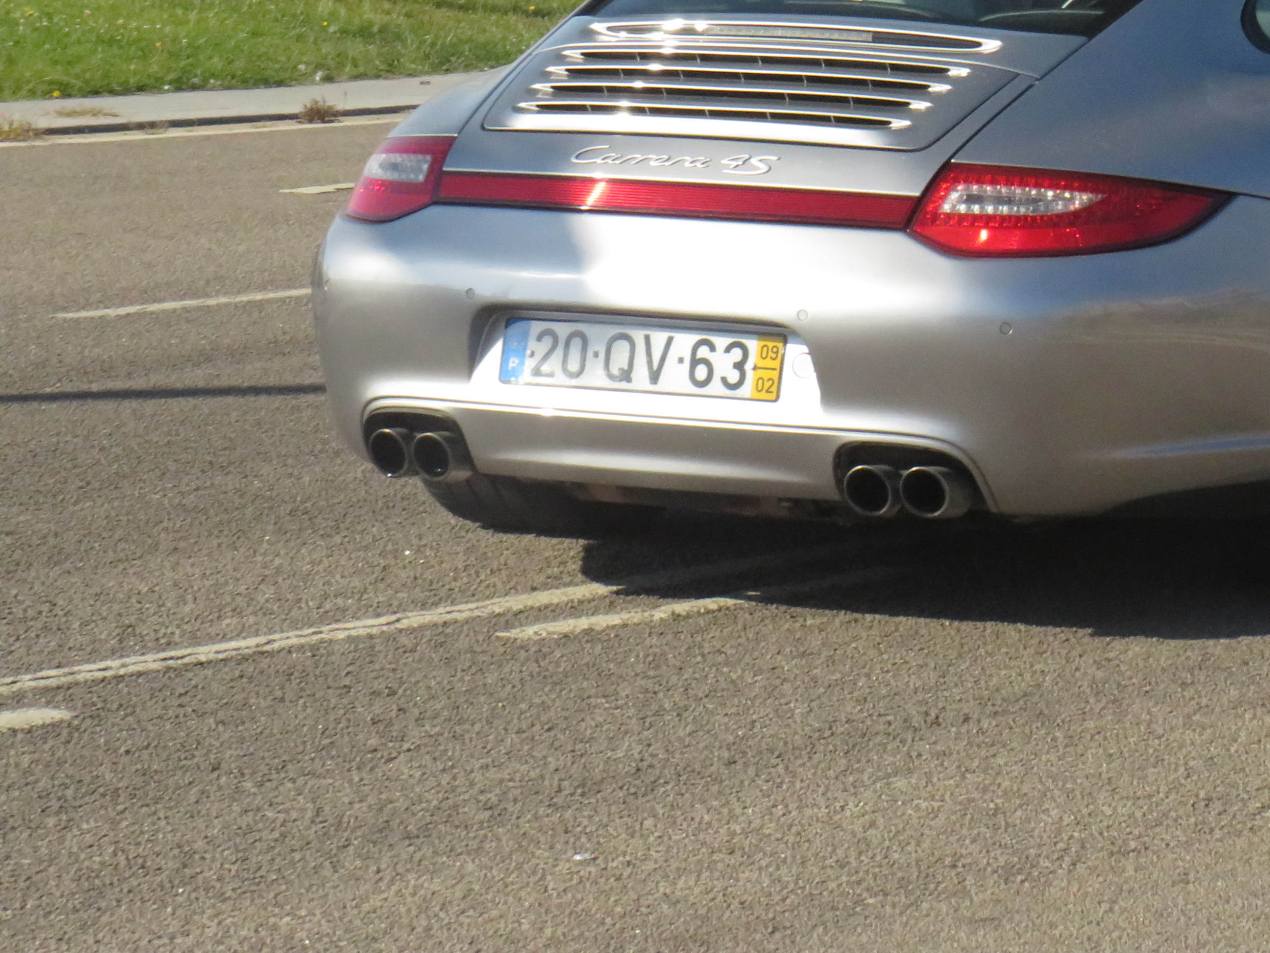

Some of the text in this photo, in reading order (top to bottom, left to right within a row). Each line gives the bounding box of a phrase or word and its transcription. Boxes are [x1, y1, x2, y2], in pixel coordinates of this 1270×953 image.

[570, 145, 781, 175] Carrera 4S
[760, 344, 779, 361] 09
[755, 377, 775, 394] 02
